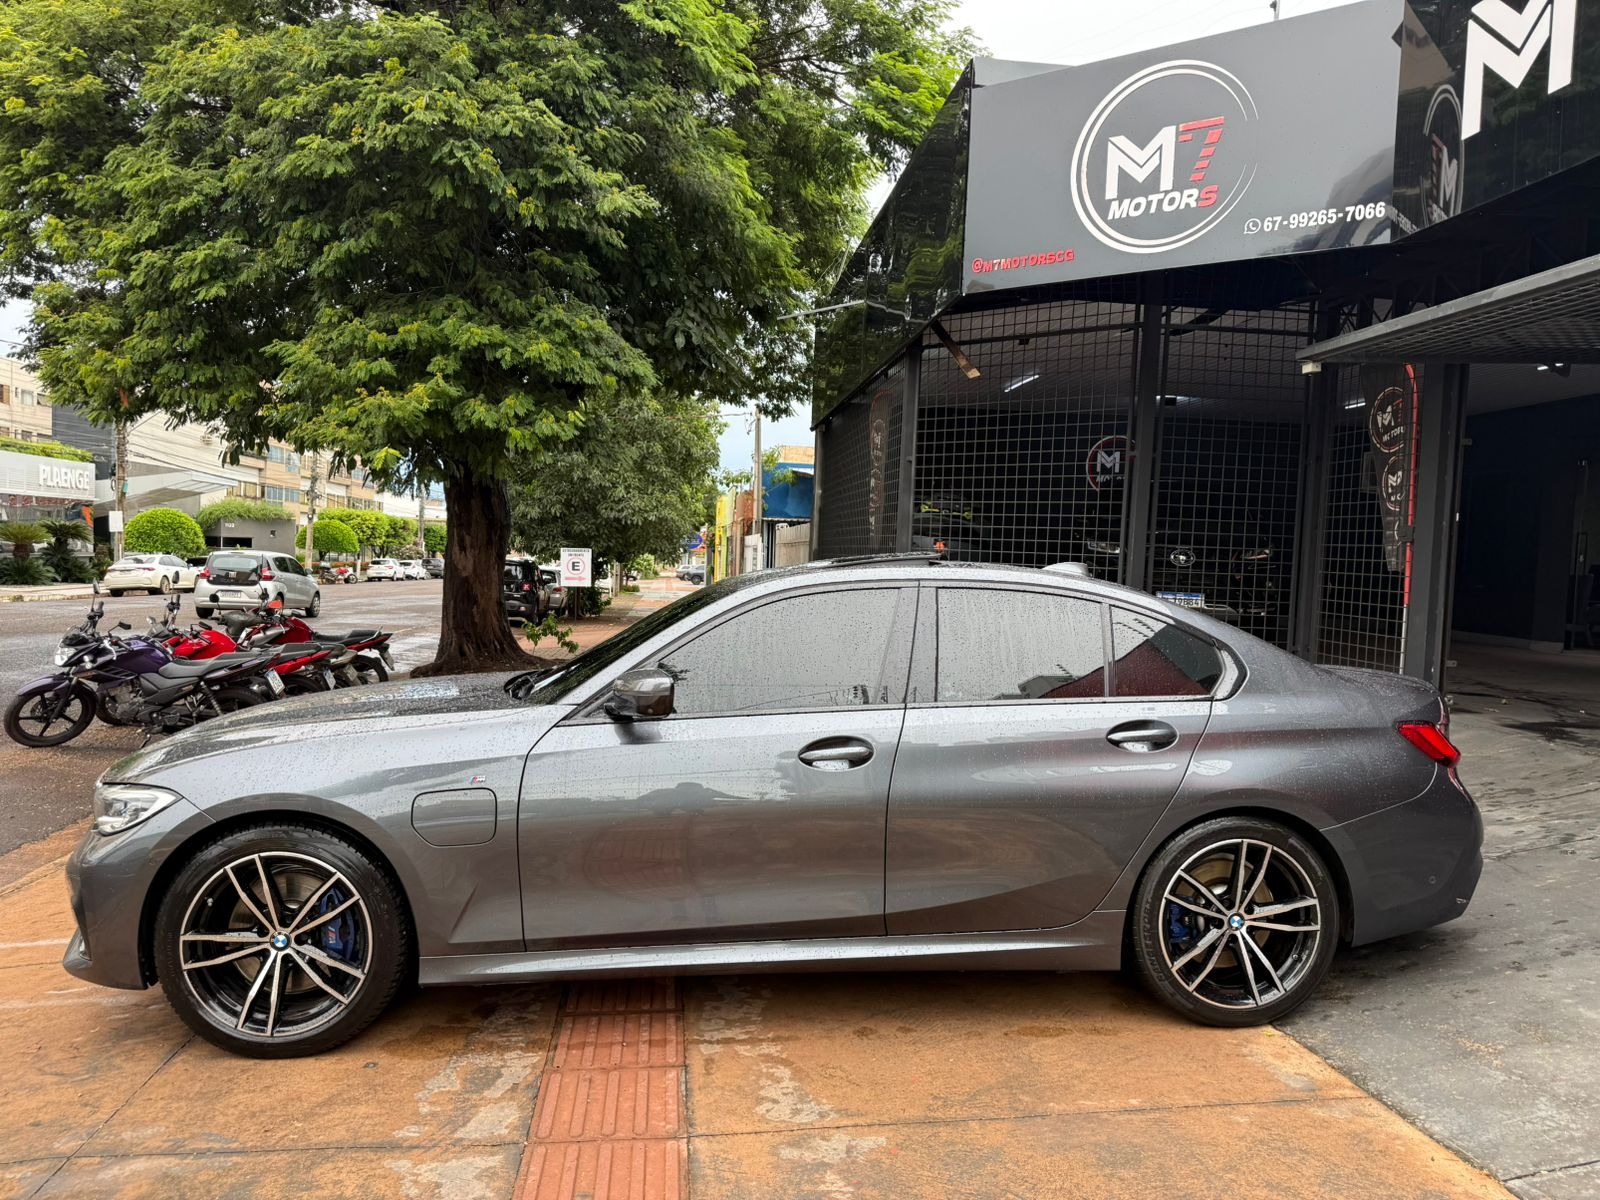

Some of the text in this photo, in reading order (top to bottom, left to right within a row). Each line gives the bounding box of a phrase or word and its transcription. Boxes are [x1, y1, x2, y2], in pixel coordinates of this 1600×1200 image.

[1105, 115, 1225, 201] M7
[1107, 184, 1219, 221] MOTORS
[1263, 201, 1386, 232] 67-99265-7066
[972, 249, 1075, 273] @M7MOTORSCG
[39, 464, 90, 490] PLAENGE
[571, 561, 581, 571] E
